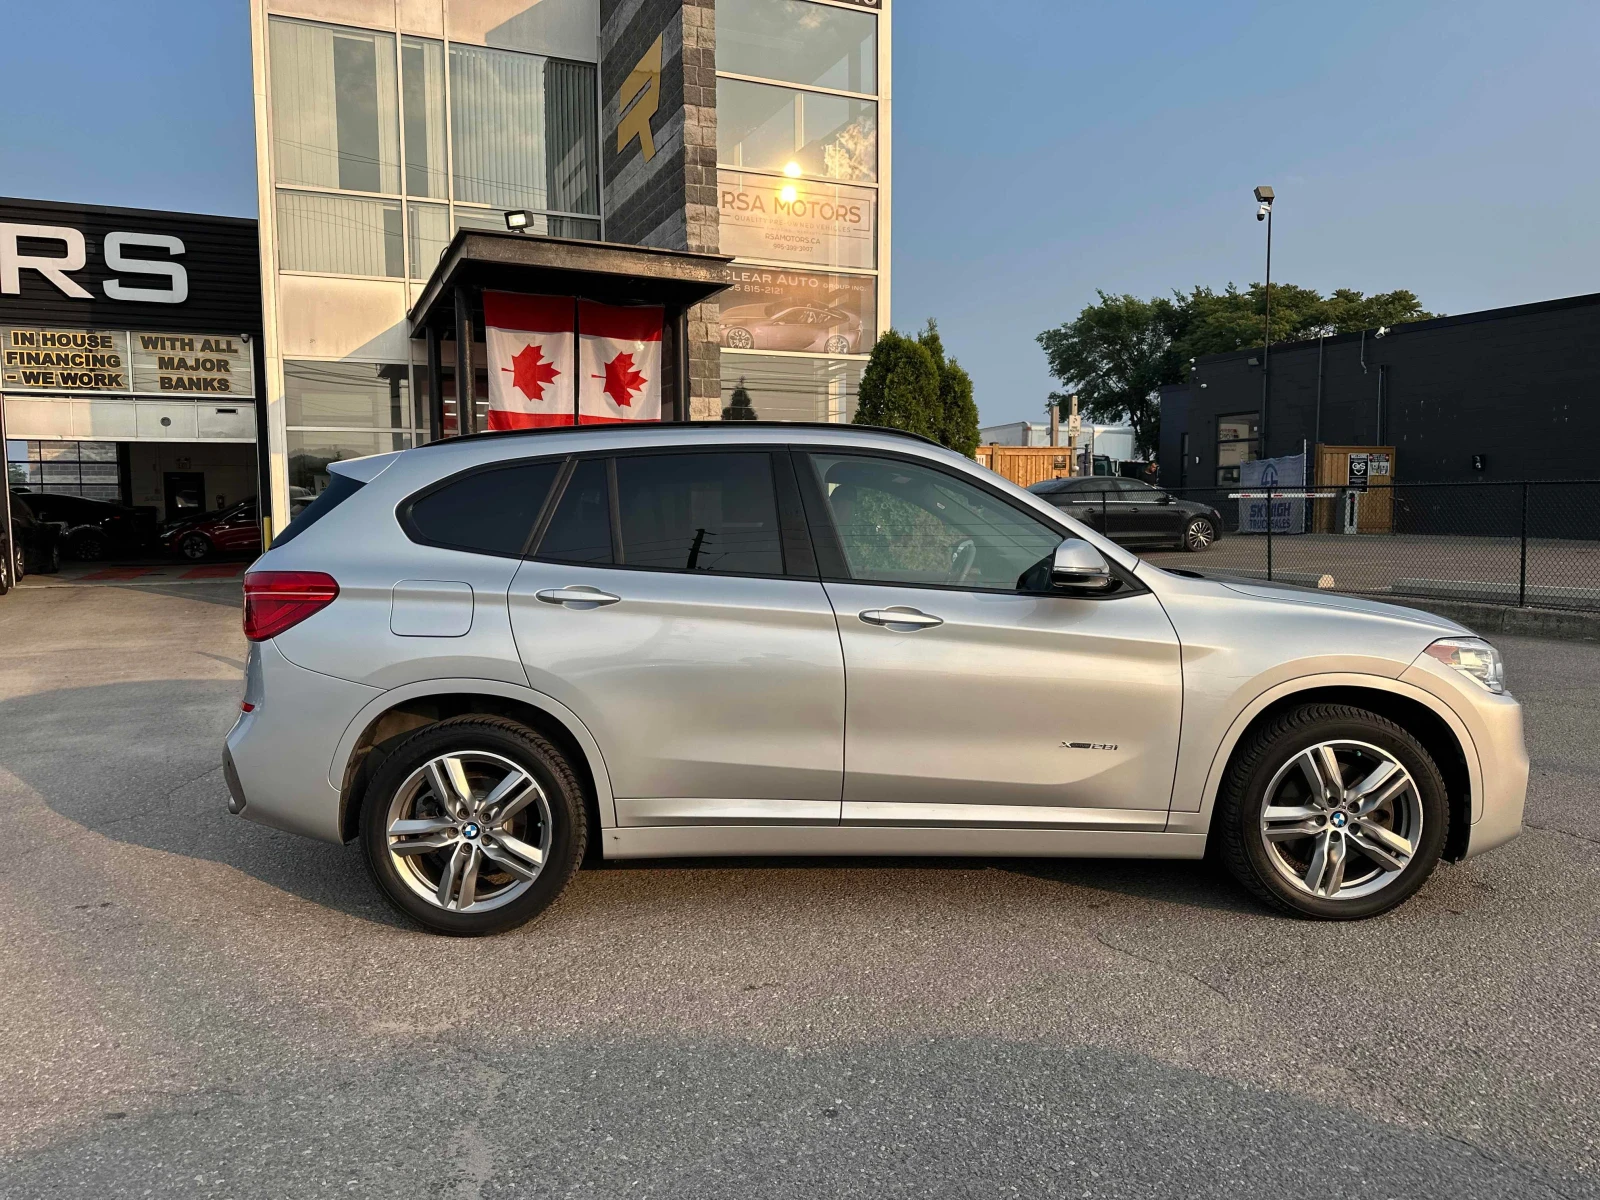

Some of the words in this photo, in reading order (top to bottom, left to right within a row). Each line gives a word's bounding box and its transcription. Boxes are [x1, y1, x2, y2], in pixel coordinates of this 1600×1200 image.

[721, 190, 766, 214] RSA
[774, 196, 862, 225] MOTORS
[734, 214, 767, 224] QUALITY
[769, 218, 815, 229] PRE-OWNED
[816, 223, 851, 233] VEHICLES
[764, 232, 821, 245] RSAMOTORS.CA
[0, 222, 189, 304] RS
[744, 284, 784, 295] 815-2121
[776, 274, 819, 288] AUTO
[822, 282, 850, 291] GROUP
[11, 331, 35, 346] IN
[41, 331, 113, 349] HOUSE
[140, 335, 195, 352] WITH
[200, 338, 239, 354] ALL
[6, 351, 121, 368] FINANCING
[158, 356, 231, 373] MAJOR
[21, 371, 55, 386] WE
[59, 372, 123, 388] WORK
[159, 376, 230, 392] BANKS
